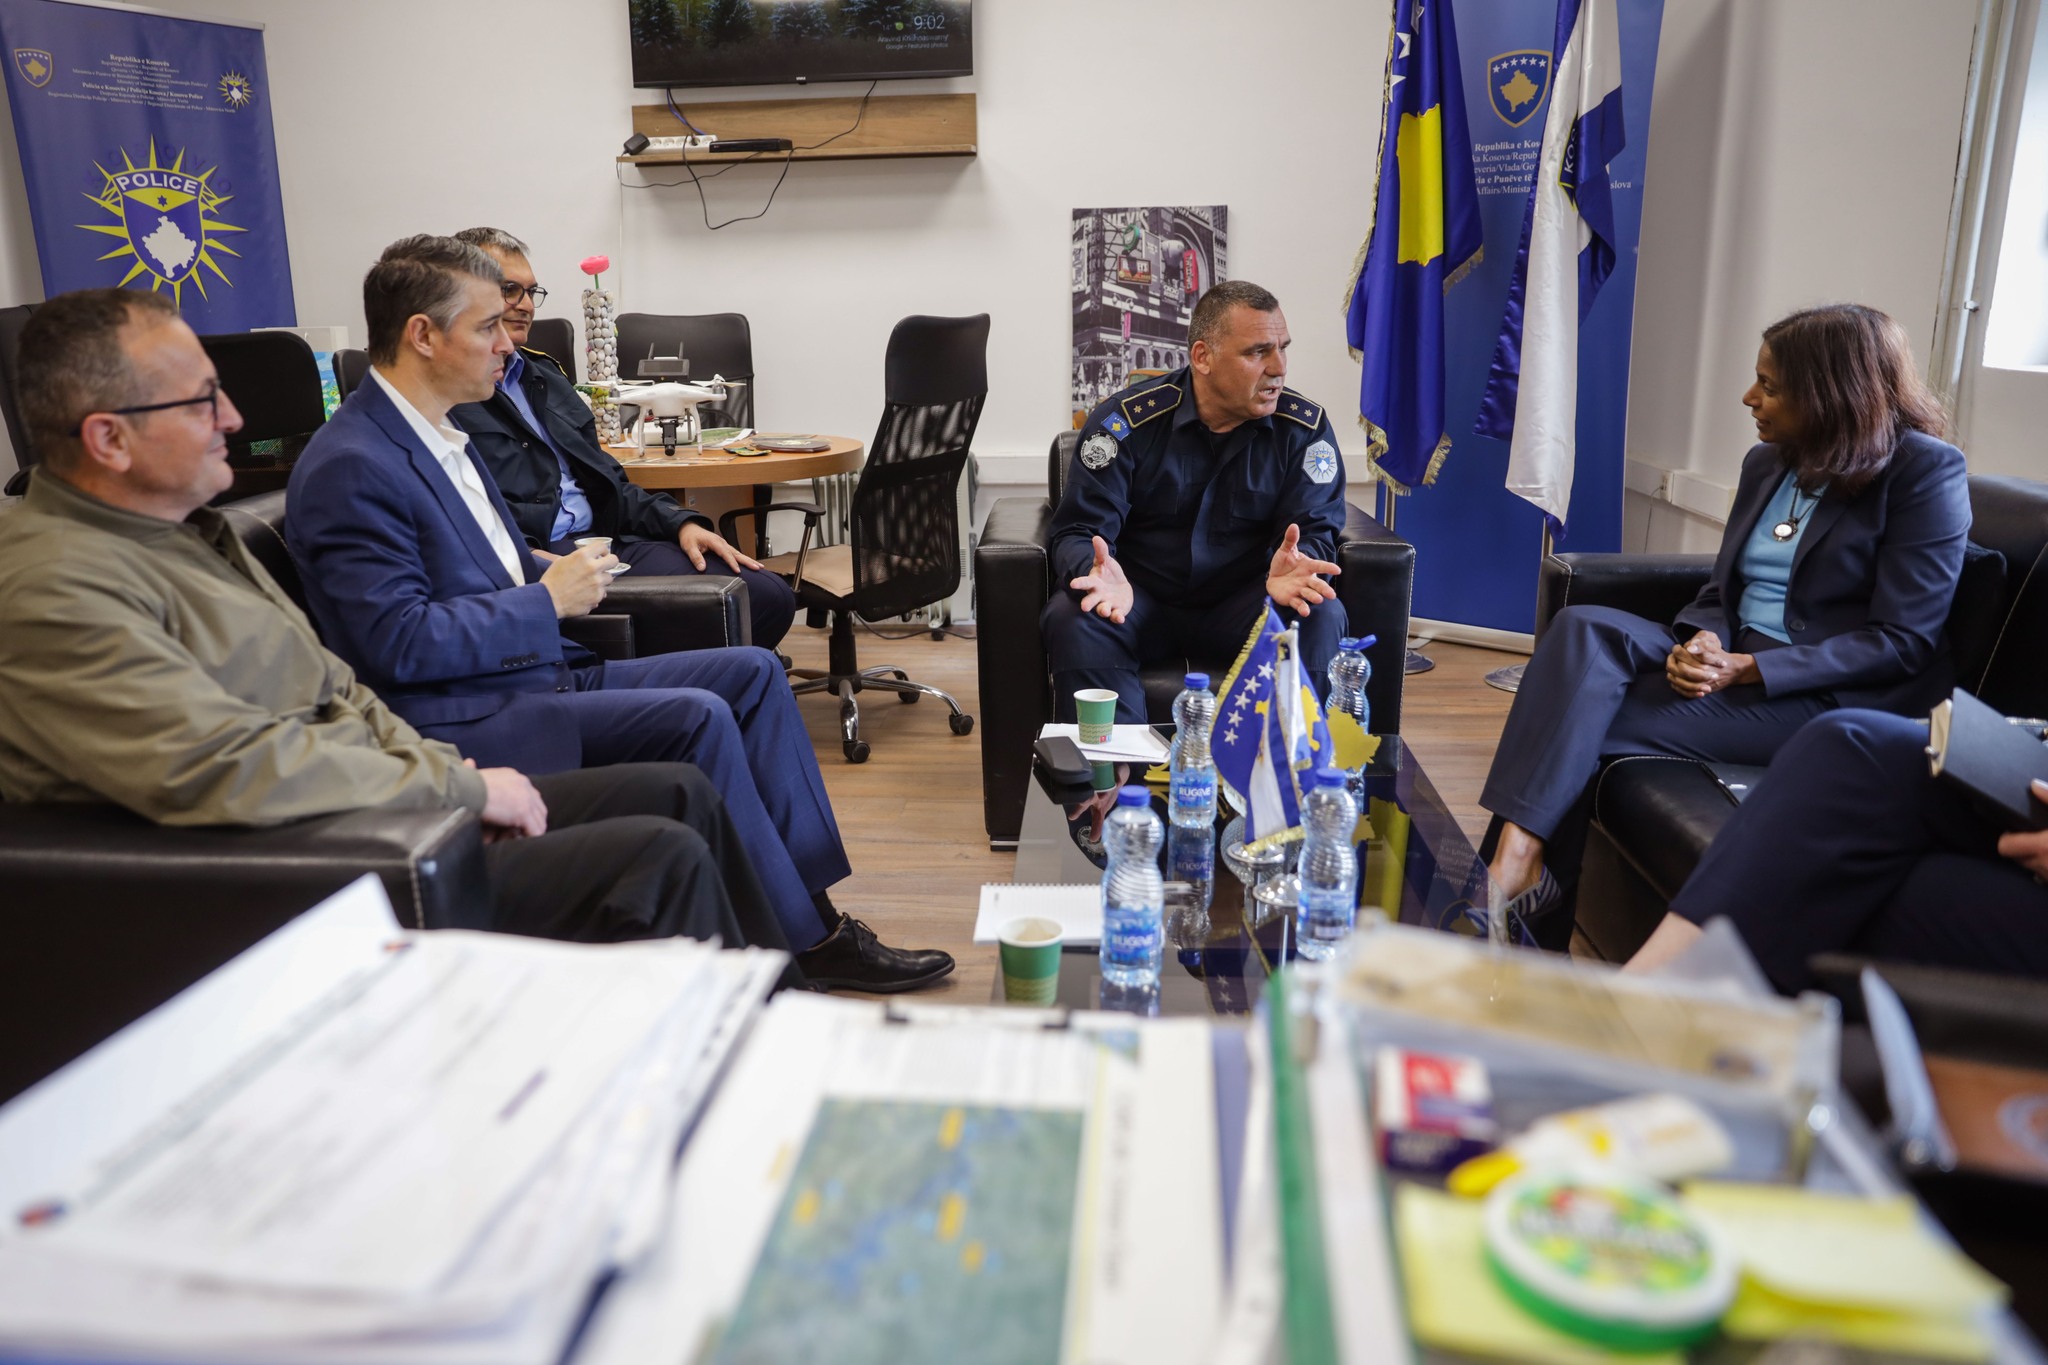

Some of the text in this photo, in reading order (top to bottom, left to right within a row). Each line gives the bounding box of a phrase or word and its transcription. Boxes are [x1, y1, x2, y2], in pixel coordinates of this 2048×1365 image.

[913, 15, 945, 30] 9:02
[110, 54, 141, 63] Republika
[1474, 142, 1515, 153] Republika
[116, 172, 198, 195] POLICE
[1494, 174, 1522, 183] Punëve
